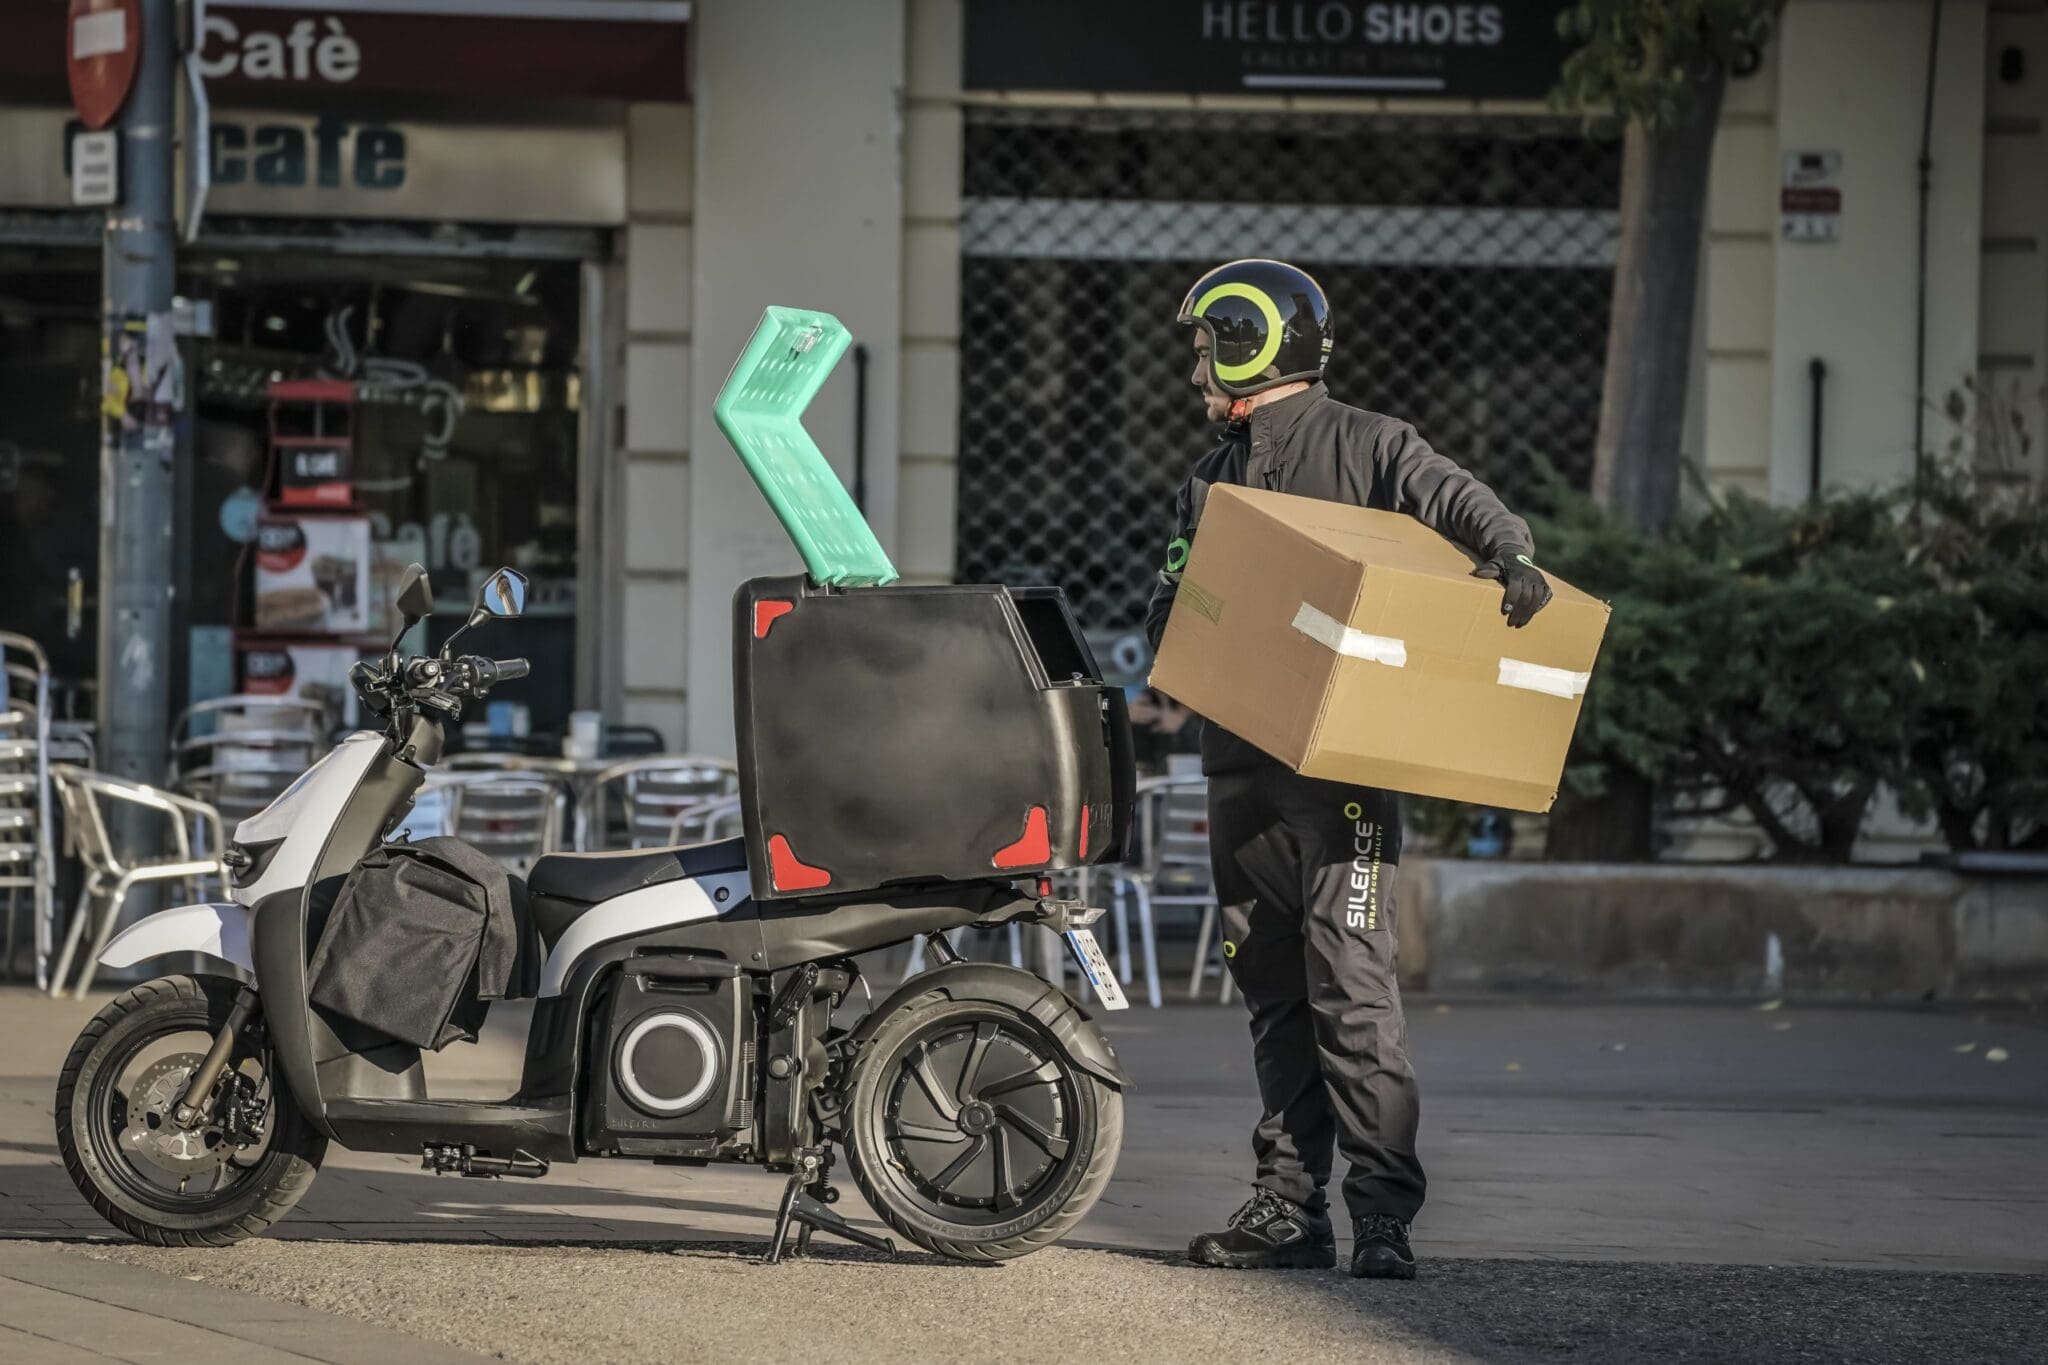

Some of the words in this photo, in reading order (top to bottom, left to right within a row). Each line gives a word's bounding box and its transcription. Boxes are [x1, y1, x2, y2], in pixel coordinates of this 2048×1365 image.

[200, 15, 361, 82] Cafè
[1201, 1, 1352, 42] HELLO
[1364, 3, 1503, 44] SHOES
[1370, 824, 1383, 894] ECOMOBILITY
[1368, 897, 1377, 930] URBAN
